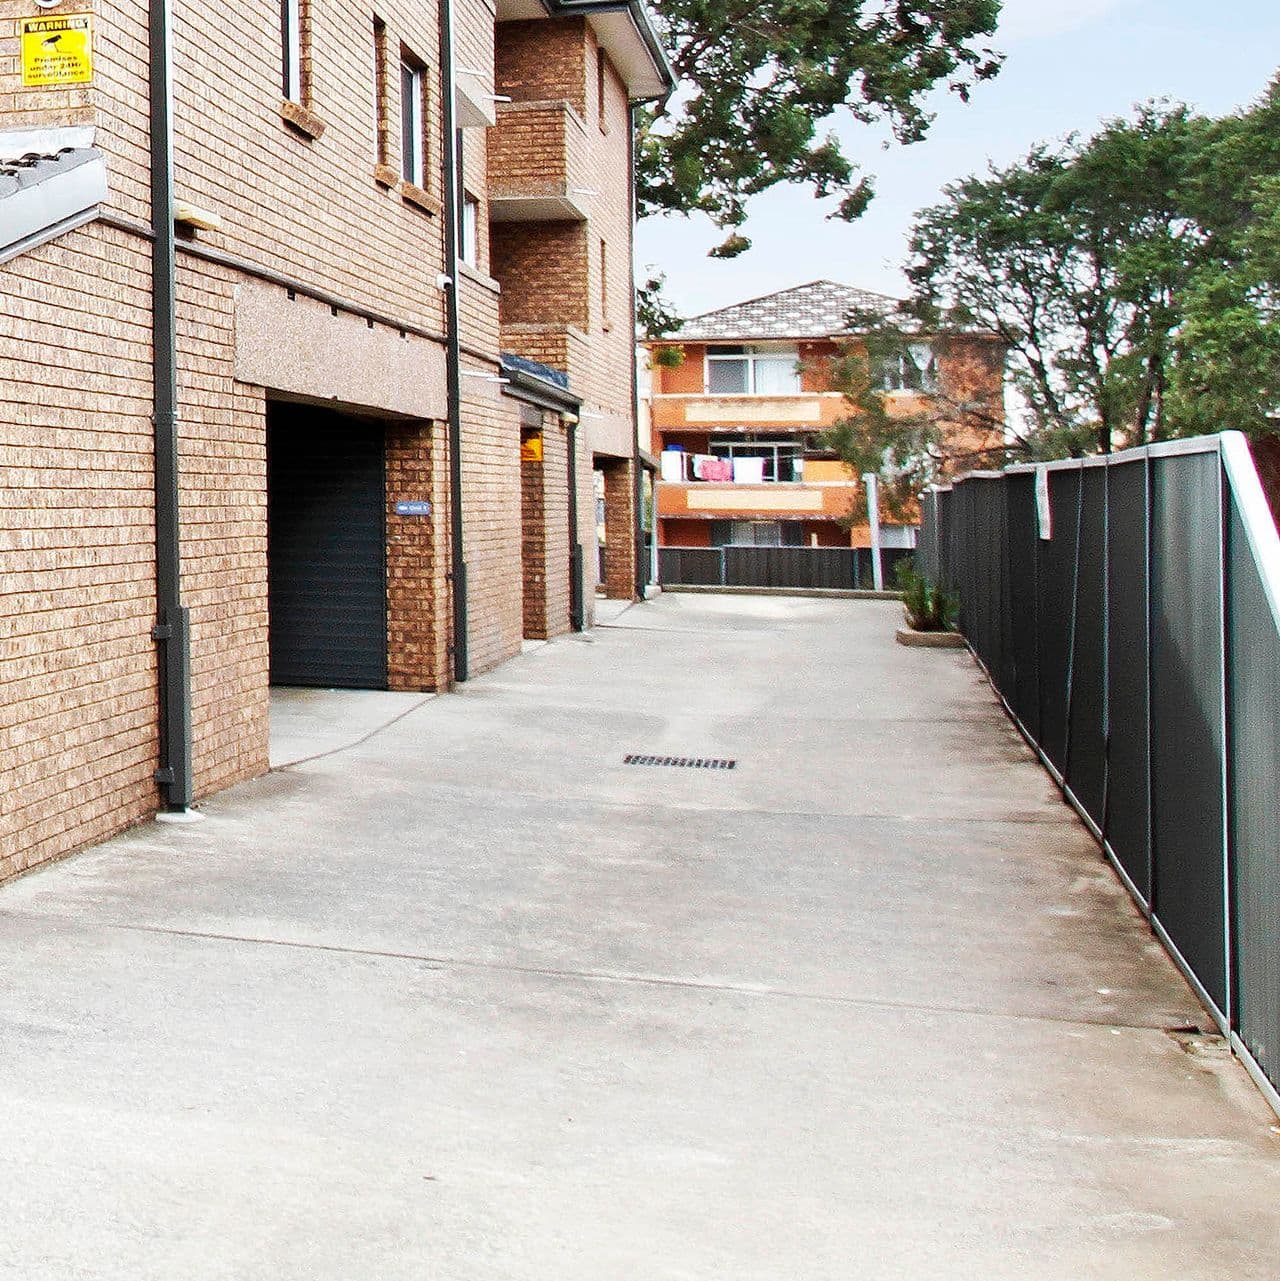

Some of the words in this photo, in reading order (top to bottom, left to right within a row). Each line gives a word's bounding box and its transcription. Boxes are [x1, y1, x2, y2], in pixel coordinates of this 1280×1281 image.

[28, 20, 85, 32] WARNING
[34, 55, 78, 63] Premises
[27, 70, 85, 79] surveillance
